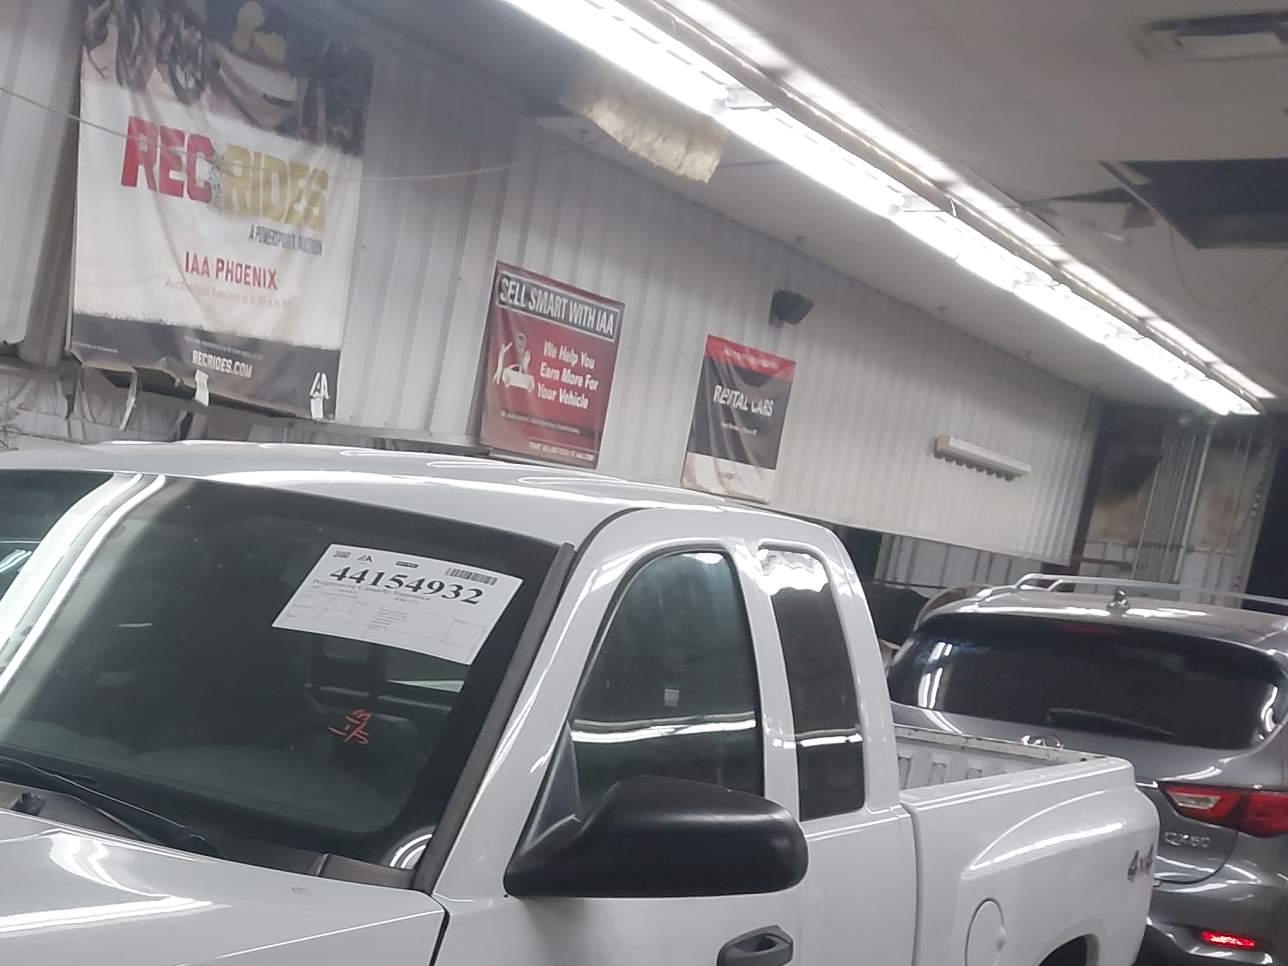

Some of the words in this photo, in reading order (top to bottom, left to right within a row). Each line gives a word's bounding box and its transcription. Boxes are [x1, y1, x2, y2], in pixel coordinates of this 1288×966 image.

[121, 116, 215, 203] REC
[185, 251, 210, 278] IAA
[215, 258, 278, 290] PHOENIX
[500, 278, 526, 308] SELL
[528, 287, 568, 320] SMART
[568, 300, 595, 329] WITH
[595, 309, 615, 336] IAA
[192, 349, 253, 379] RECRIDES.COM
[543, 340, 557, 359] We
[558, 345, 579, 368] Help
[580, 351, 595, 370] You
[539, 360, 560, 382] Earn
[560, 367, 584, 388] More
[584, 374, 599, 391] For
[537, 382, 557, 402] Your
[559, 387, 589, 410] Vehicle
[328, 566, 484, 606] 44154932
